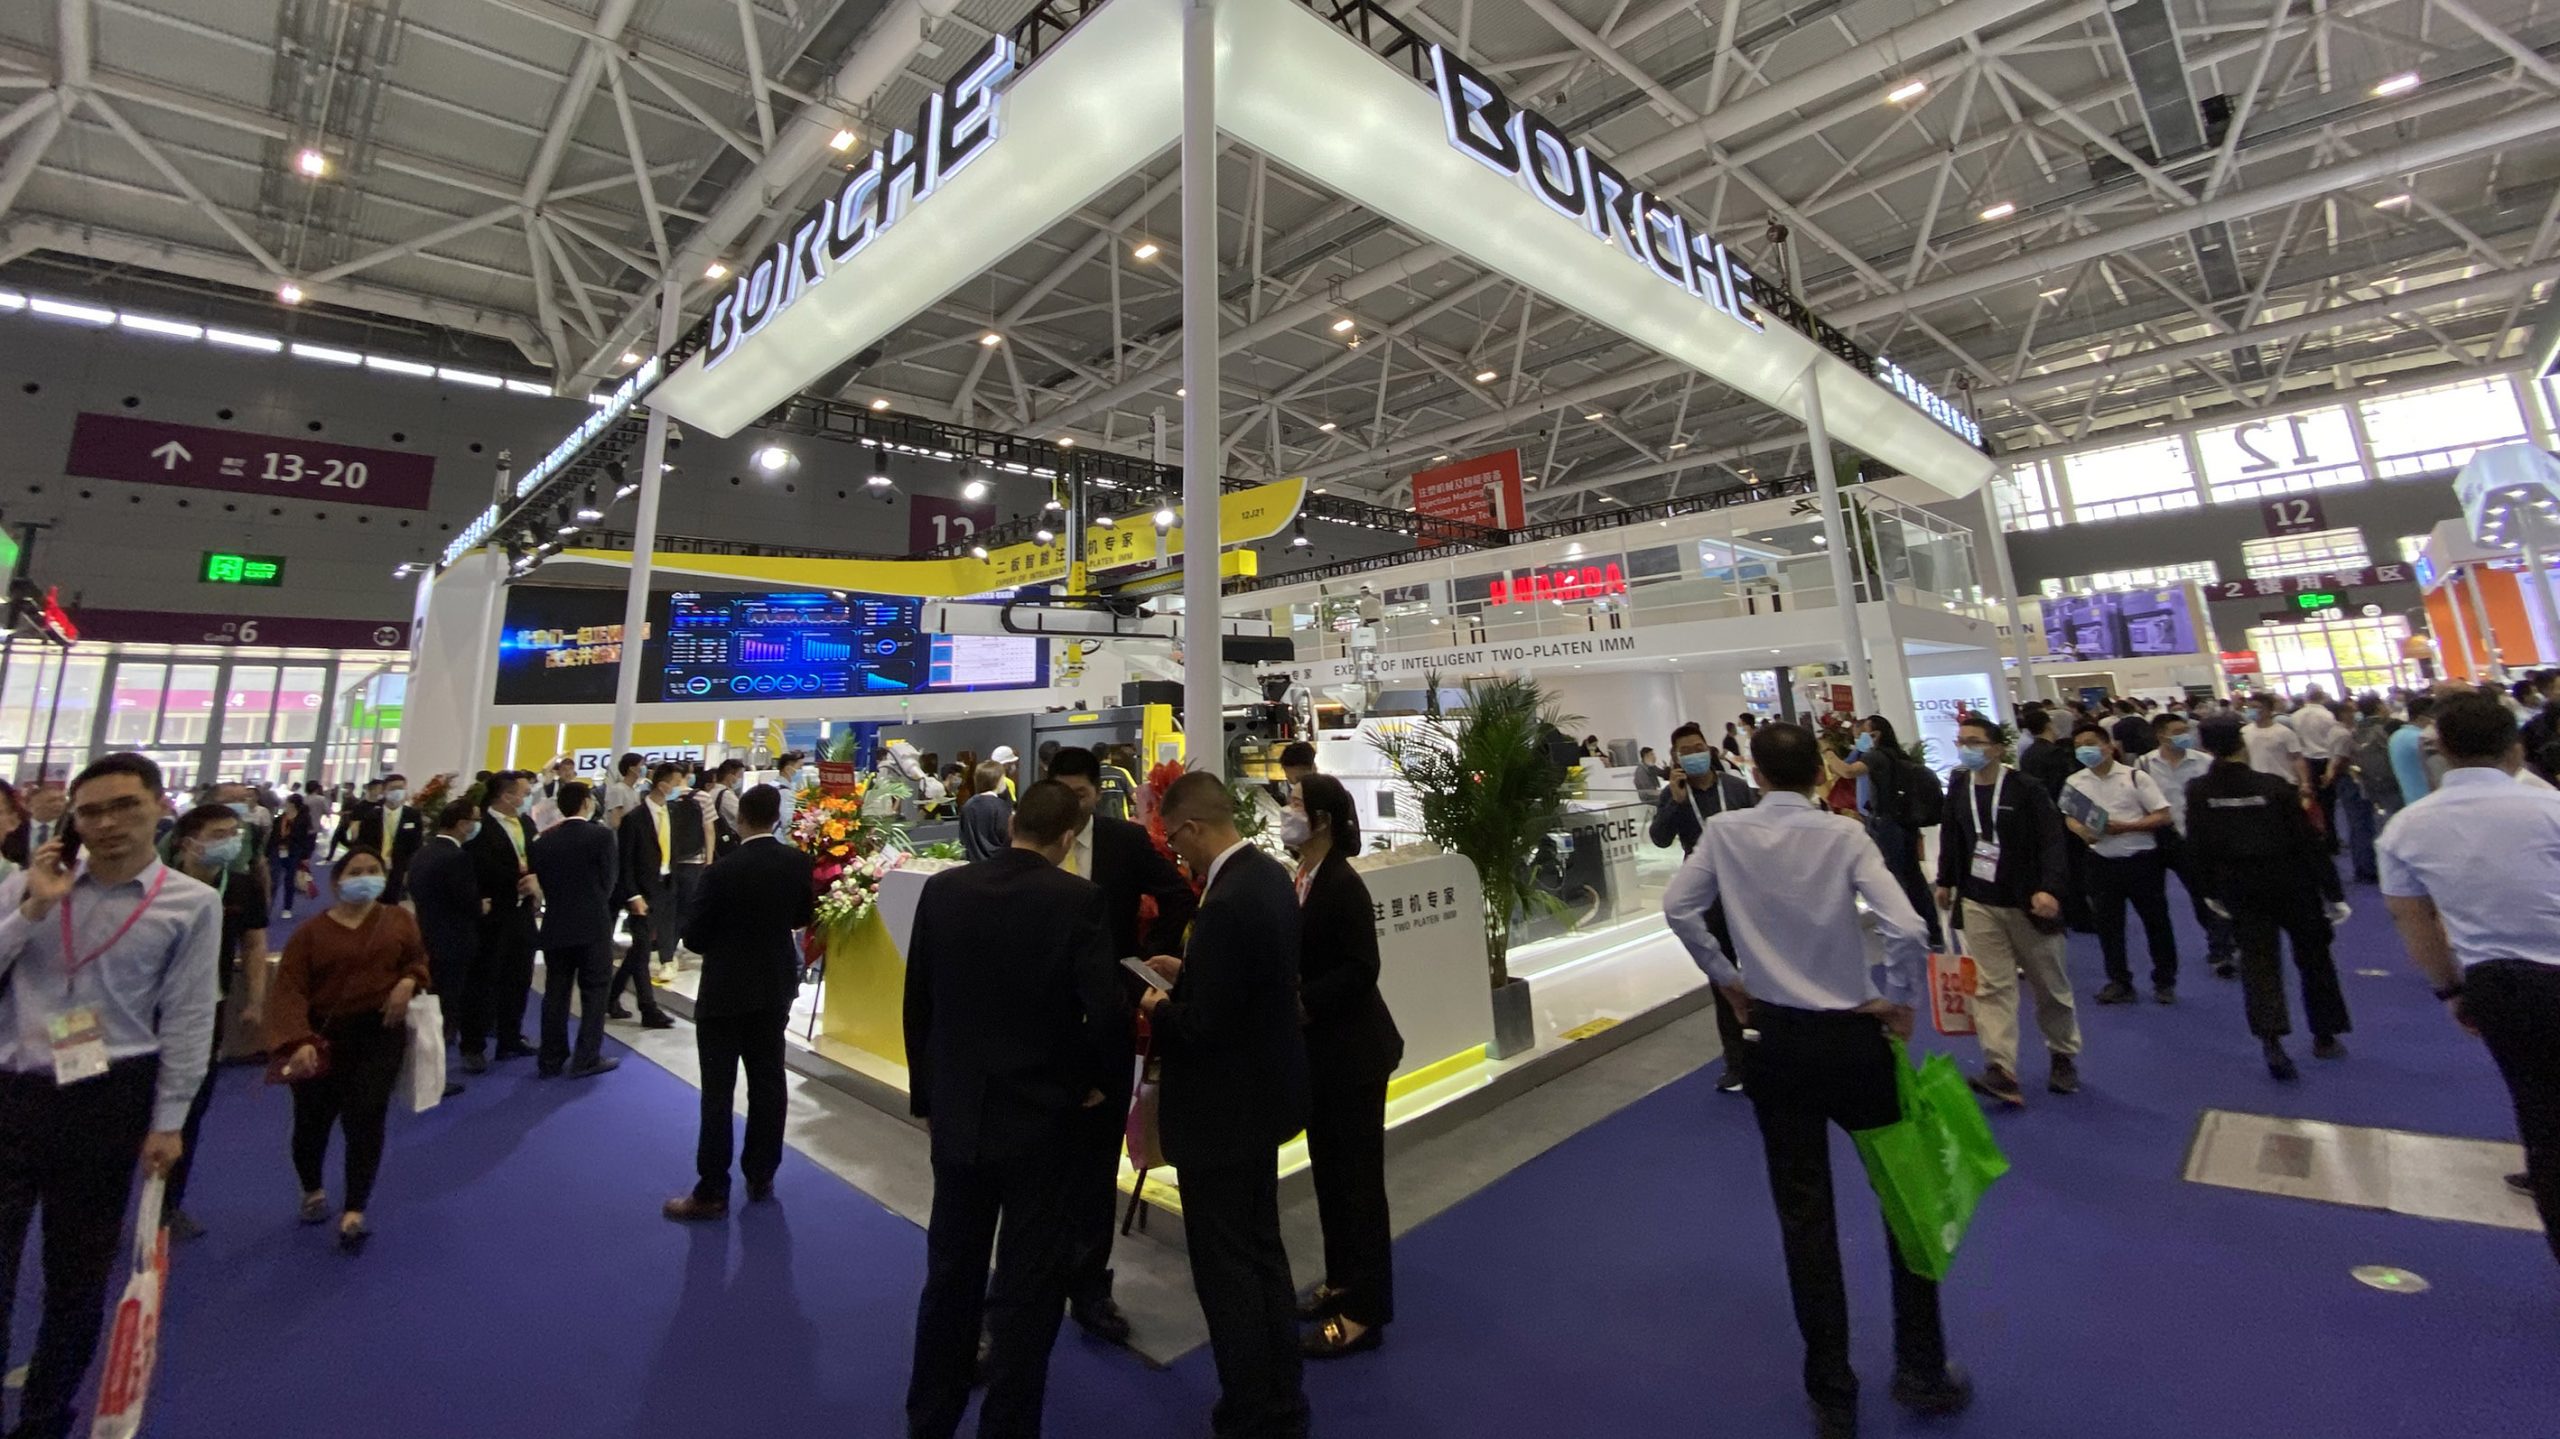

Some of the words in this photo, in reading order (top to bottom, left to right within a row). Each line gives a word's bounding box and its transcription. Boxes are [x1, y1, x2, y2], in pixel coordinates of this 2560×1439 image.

[703, 34, 1016, 372] BORCHE
[1431, 44, 1764, 334] BORCHE
[261, 452, 368, 489] 13-20
[1241, 507, 1264, 520] 12J21
[2271, 499, 2315, 526] 12
[240, 620, 258, 642] 6
[1381, 659, 1396, 672] OF
[1402, 650, 1484, 670] INTELLIGENT
[1492, 640, 1593, 662] TWO-PLATEN
[1600, 636, 1635, 652] IMM
[1413, 914, 1439, 928] PLATEN
